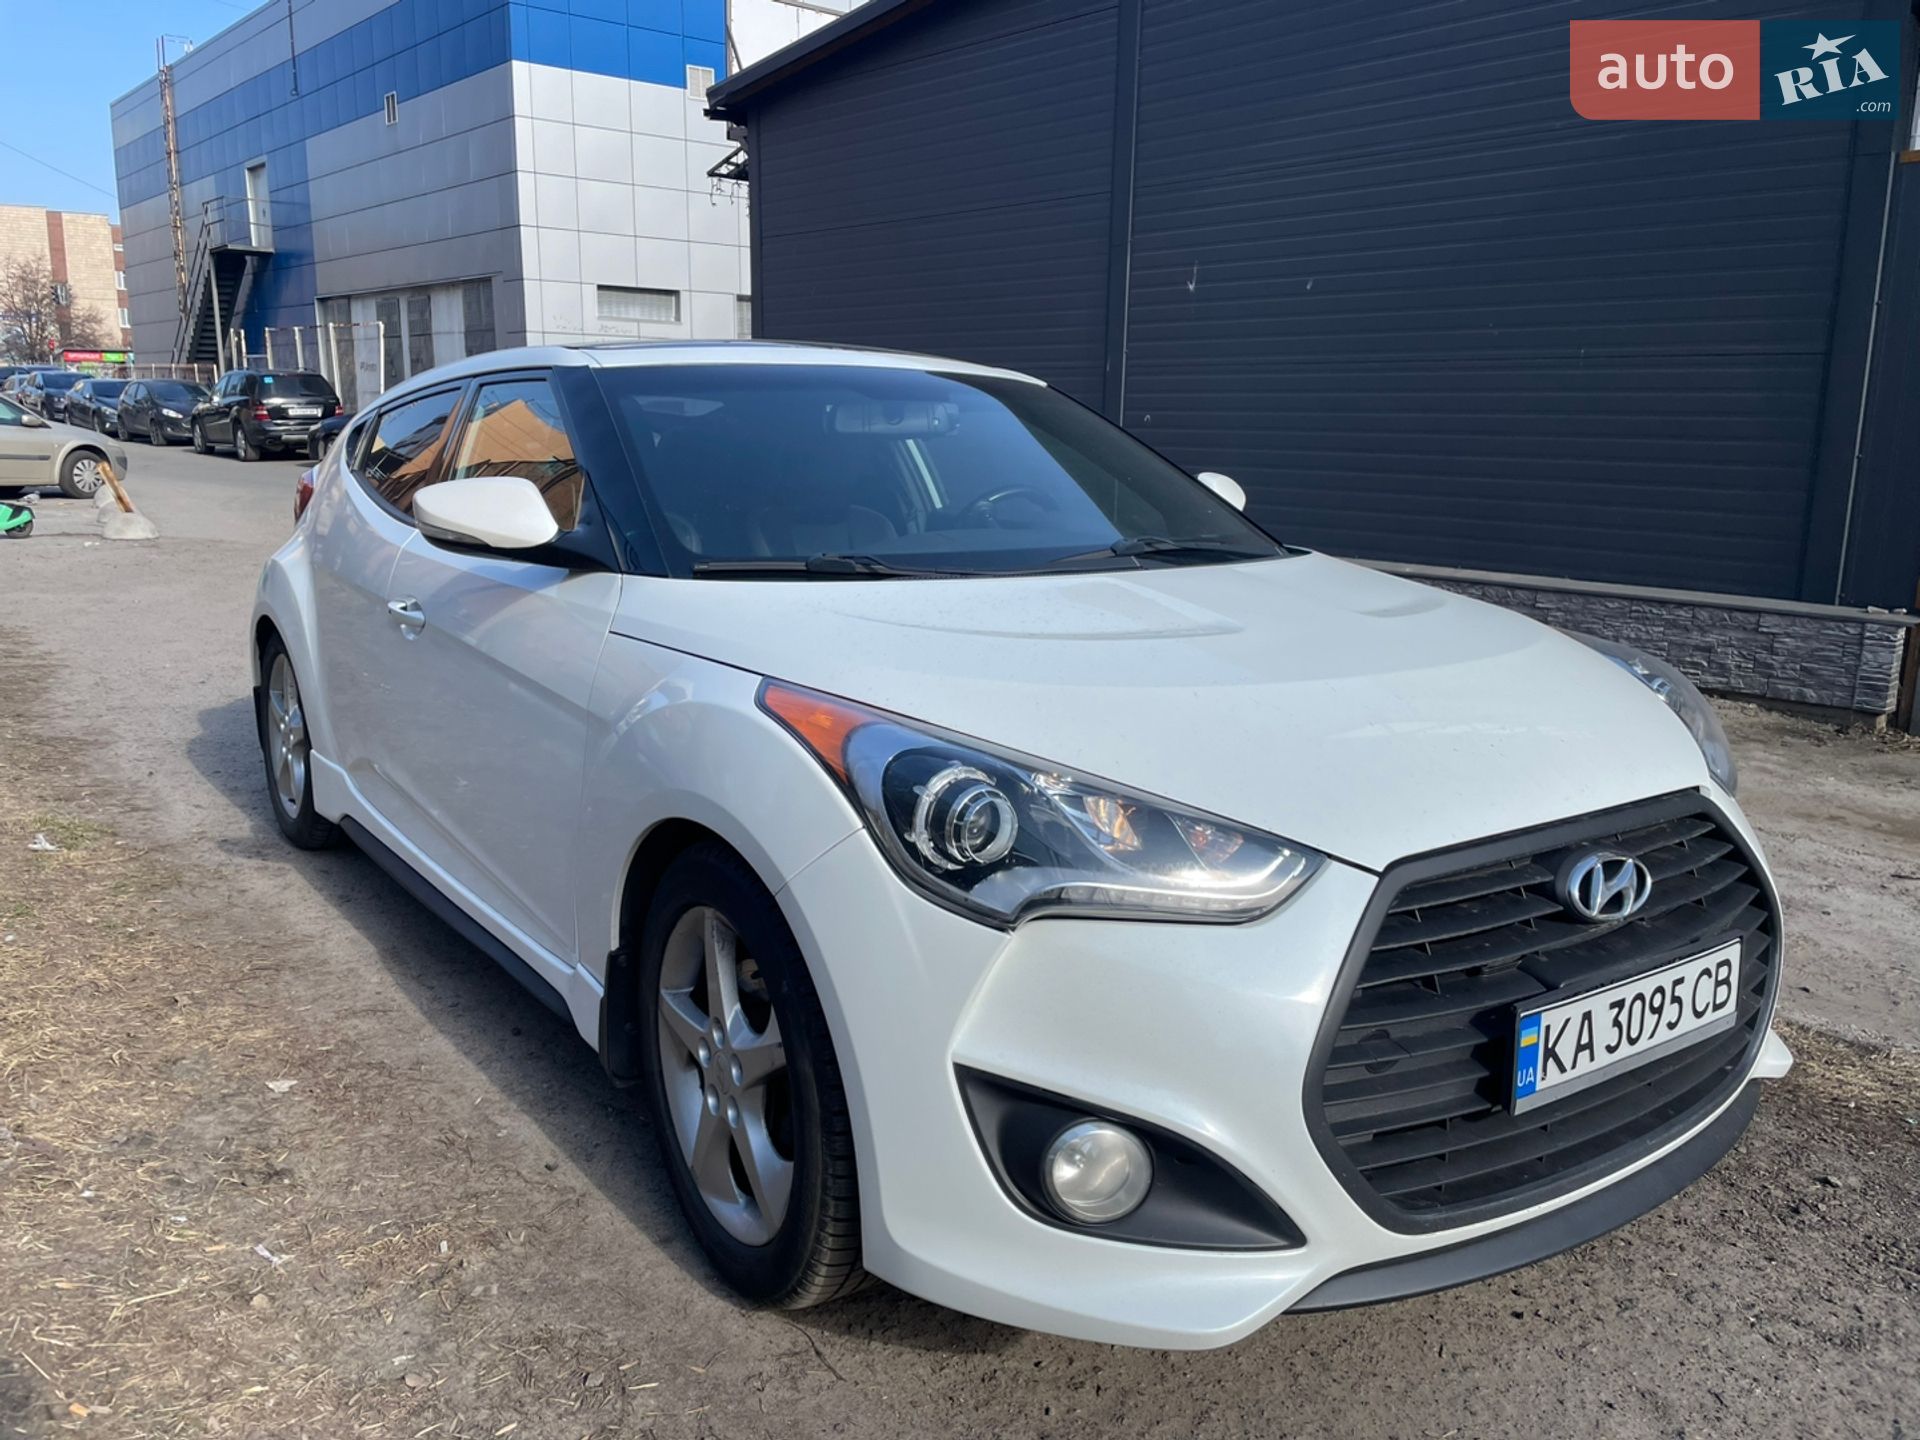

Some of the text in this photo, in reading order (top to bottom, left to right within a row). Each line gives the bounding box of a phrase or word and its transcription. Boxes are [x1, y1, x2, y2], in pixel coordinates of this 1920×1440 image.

[1541, 958, 1732, 1081] KA 3095 CB
[1517, 1066, 1535, 1087] UA
